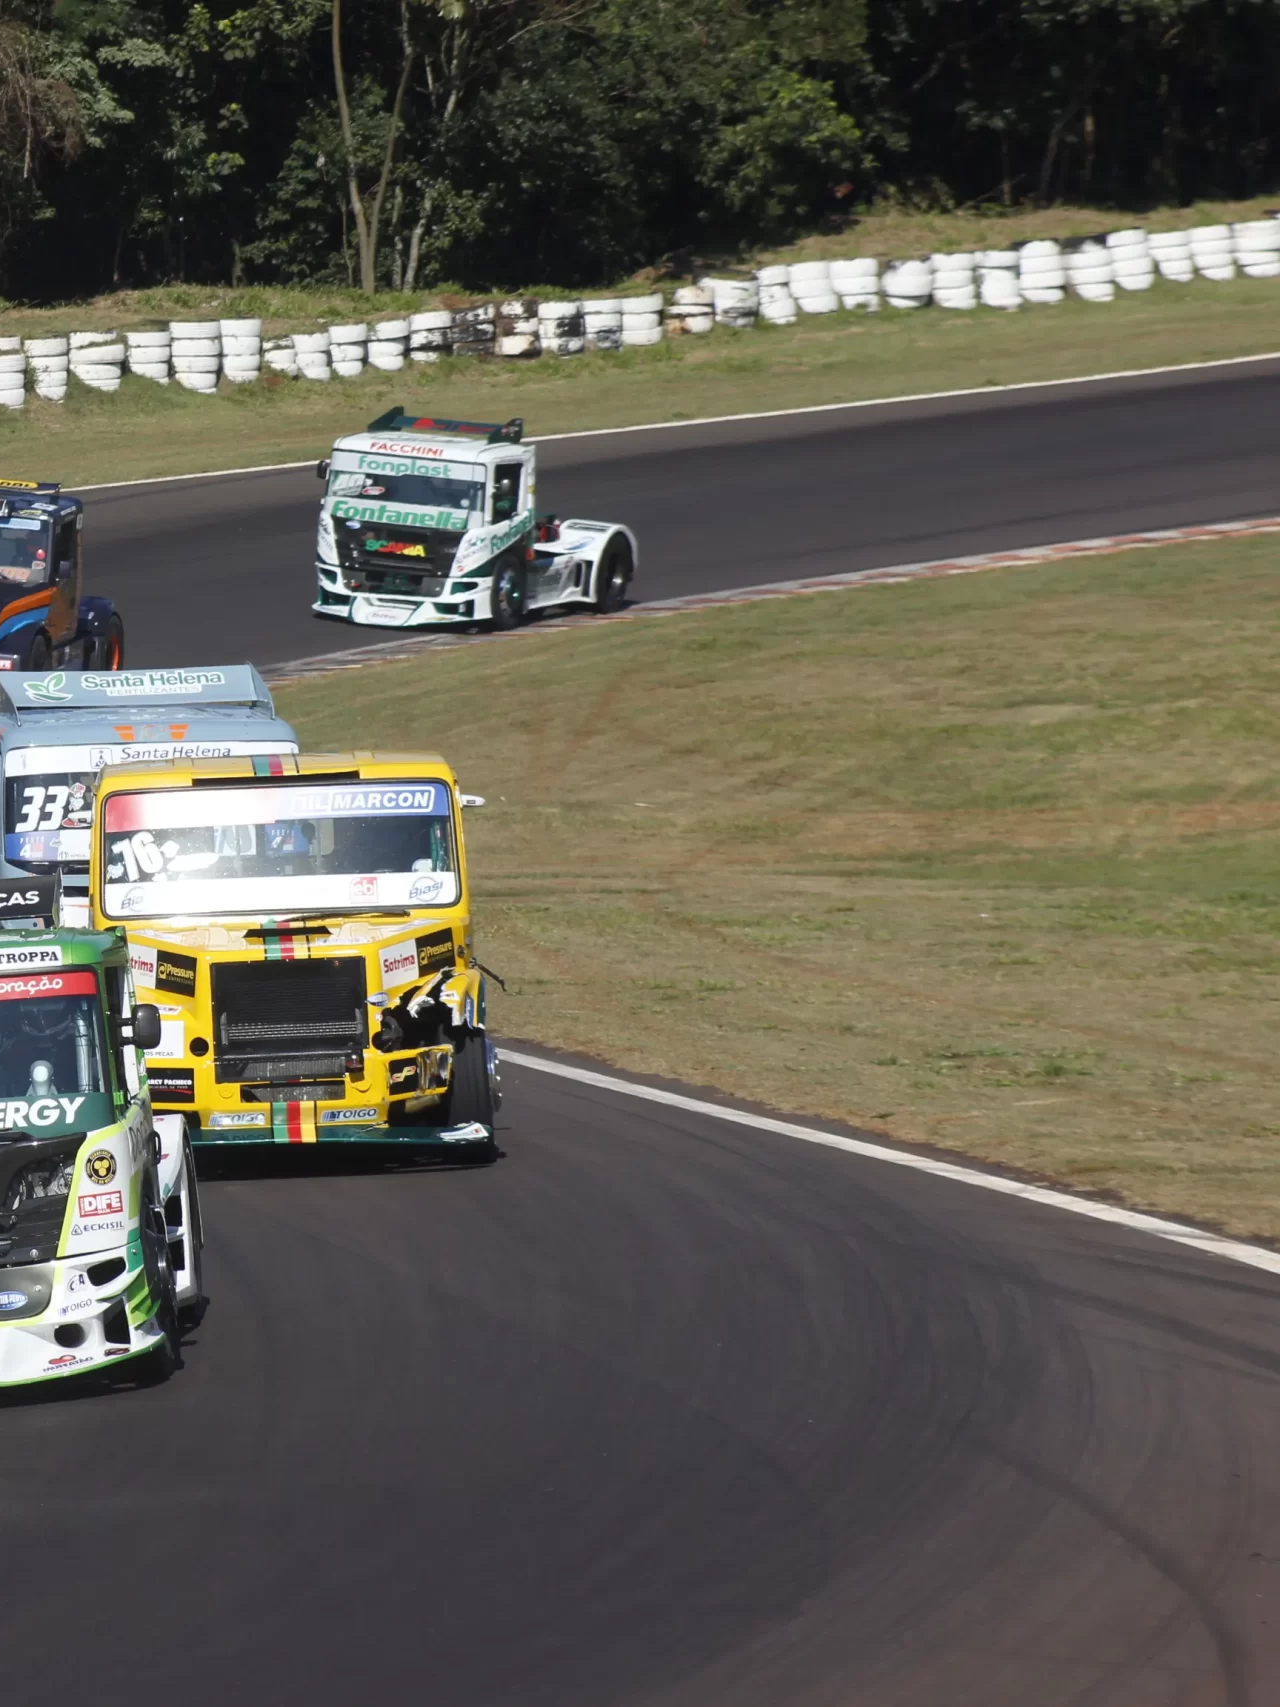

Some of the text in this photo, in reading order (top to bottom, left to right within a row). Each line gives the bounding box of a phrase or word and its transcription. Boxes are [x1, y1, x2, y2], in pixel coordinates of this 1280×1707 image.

[370, 442, 444, 457] FACCHINI
[358, 455, 451, 478] fonplast
[331, 500, 467, 529] Fontanella
[83, 671, 223, 690] Santa Helena
[109, 685, 200, 696] FERTILIZANTES
[120, 745, 232, 760] Santa Helena
[15, 785, 69, 833] 33
[334, 791, 429, 809] MARCON
[111, 831, 164, 882] 16
[409, 881, 444, 901] Biasi
[426, 941, 452, 957] Pressure
[130, 955, 154, 973] trima
[167, 963, 194, 980] Pressure
[384, 953, 415, 974] Sotrima
[336, 1107, 377, 1120] TOIGO
[84, 1192, 121, 1211] DIFE
[83, 1221, 124, 1232] ECKISIL
[65, 1299, 93, 1314] TOIGO
